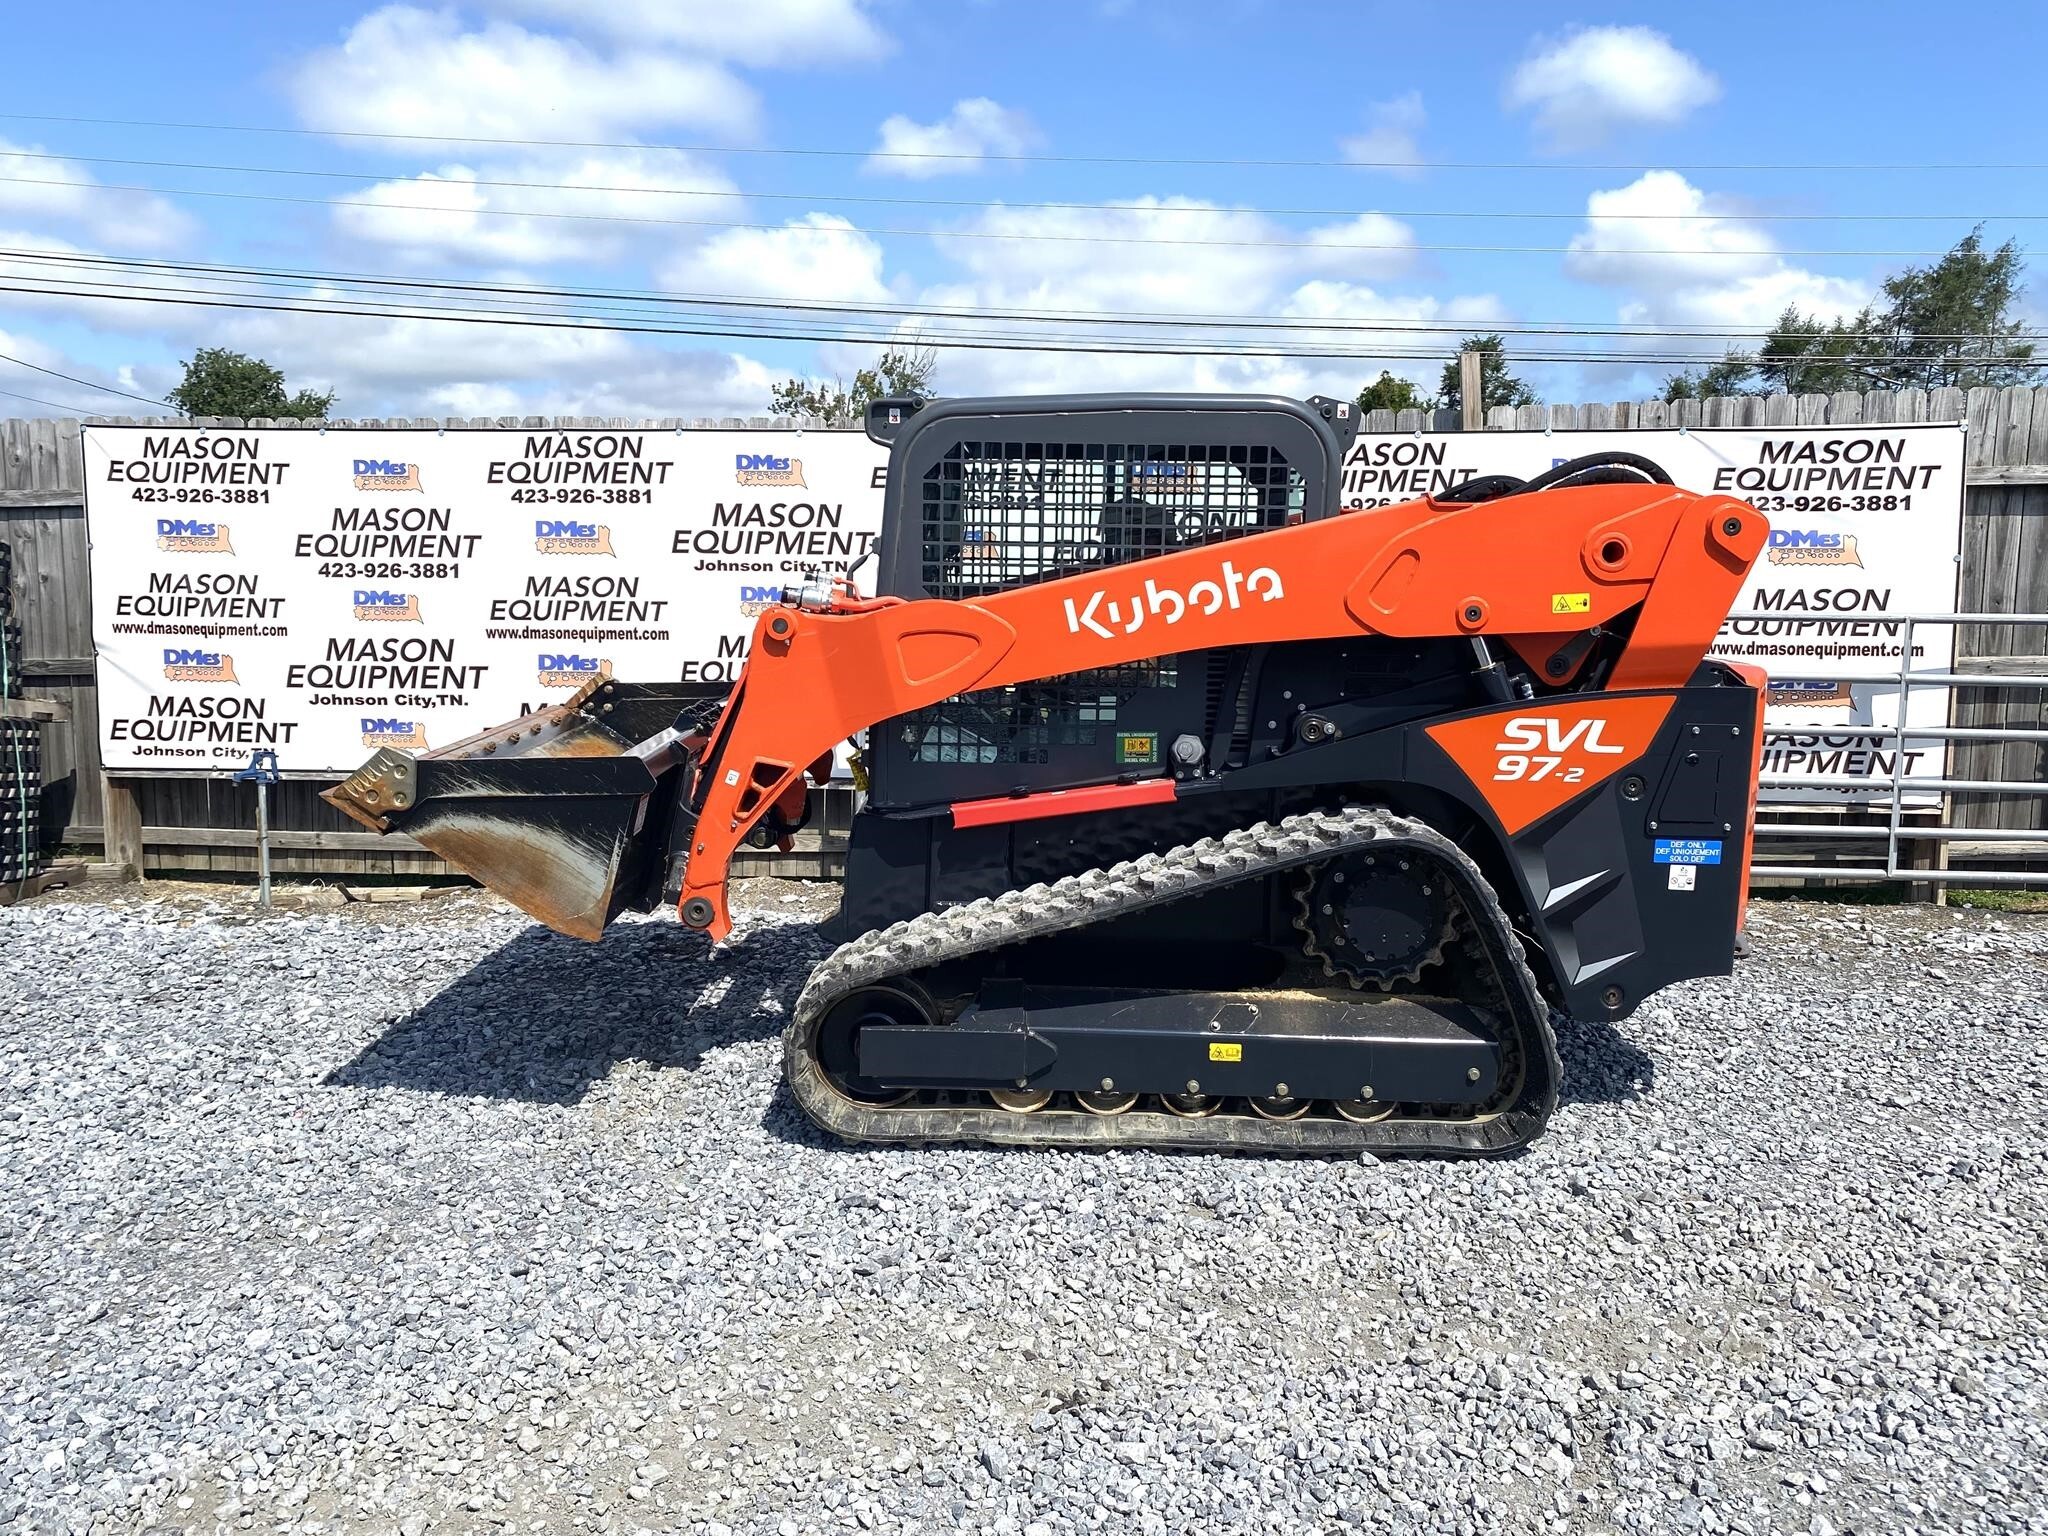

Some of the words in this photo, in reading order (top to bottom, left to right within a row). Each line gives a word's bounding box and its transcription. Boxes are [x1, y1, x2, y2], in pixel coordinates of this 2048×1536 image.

[144, 437, 259, 459] MASON
[525, 436, 643, 458] MASON
[1341, 442, 1447, 467] ASON
[1759, 439, 1905, 464] MASON
[108, 460, 289, 484] EQUIPMENT
[488, 462, 673, 483] EQUIPMENT
[1713, 466, 1941, 491] EQUIPMENT
[132, 488, 269, 503] 423-926-3881
[511, 489, 651, 503] 423-926-3881
[332, 508, 450, 531] MASON
[712, 503, 842, 527] MASON
[295, 534, 482, 558] EQUIPMENT
[671, 529, 875, 556] EQUIPMENT
[319, 563, 458, 578] 423-926-3881
[694, 560, 772, 571] Johnson
[150, 573, 258, 594] MASON
[525, 577, 638, 597] MASON
[117, 596, 285, 618] EQUIPMENT
[491, 600, 668, 621] EQUIPMENT
[1063, 560, 1285, 640] Kubota
[1753, 589, 1890, 611] MASON
[112, 621, 287, 638] www.dmasonequipment.com
[486, 626, 669, 643] www.dmasonequipment.com
[326, 638, 454, 662] MASON
[287, 665, 488, 689] EQUIPMENT
[148, 696, 265, 719] MASON
[309, 694, 387, 705] Johnson
[395, 695, 468, 708] City,TN.
[110, 718, 298, 743] EQUIPMENT
[1495, 717, 1625, 754] SVL
[133, 746, 205, 756] Johnson
[1493, 756, 1585, 783] 97-2
[1672, 848, 1720, 856] UNIQUEMENT
